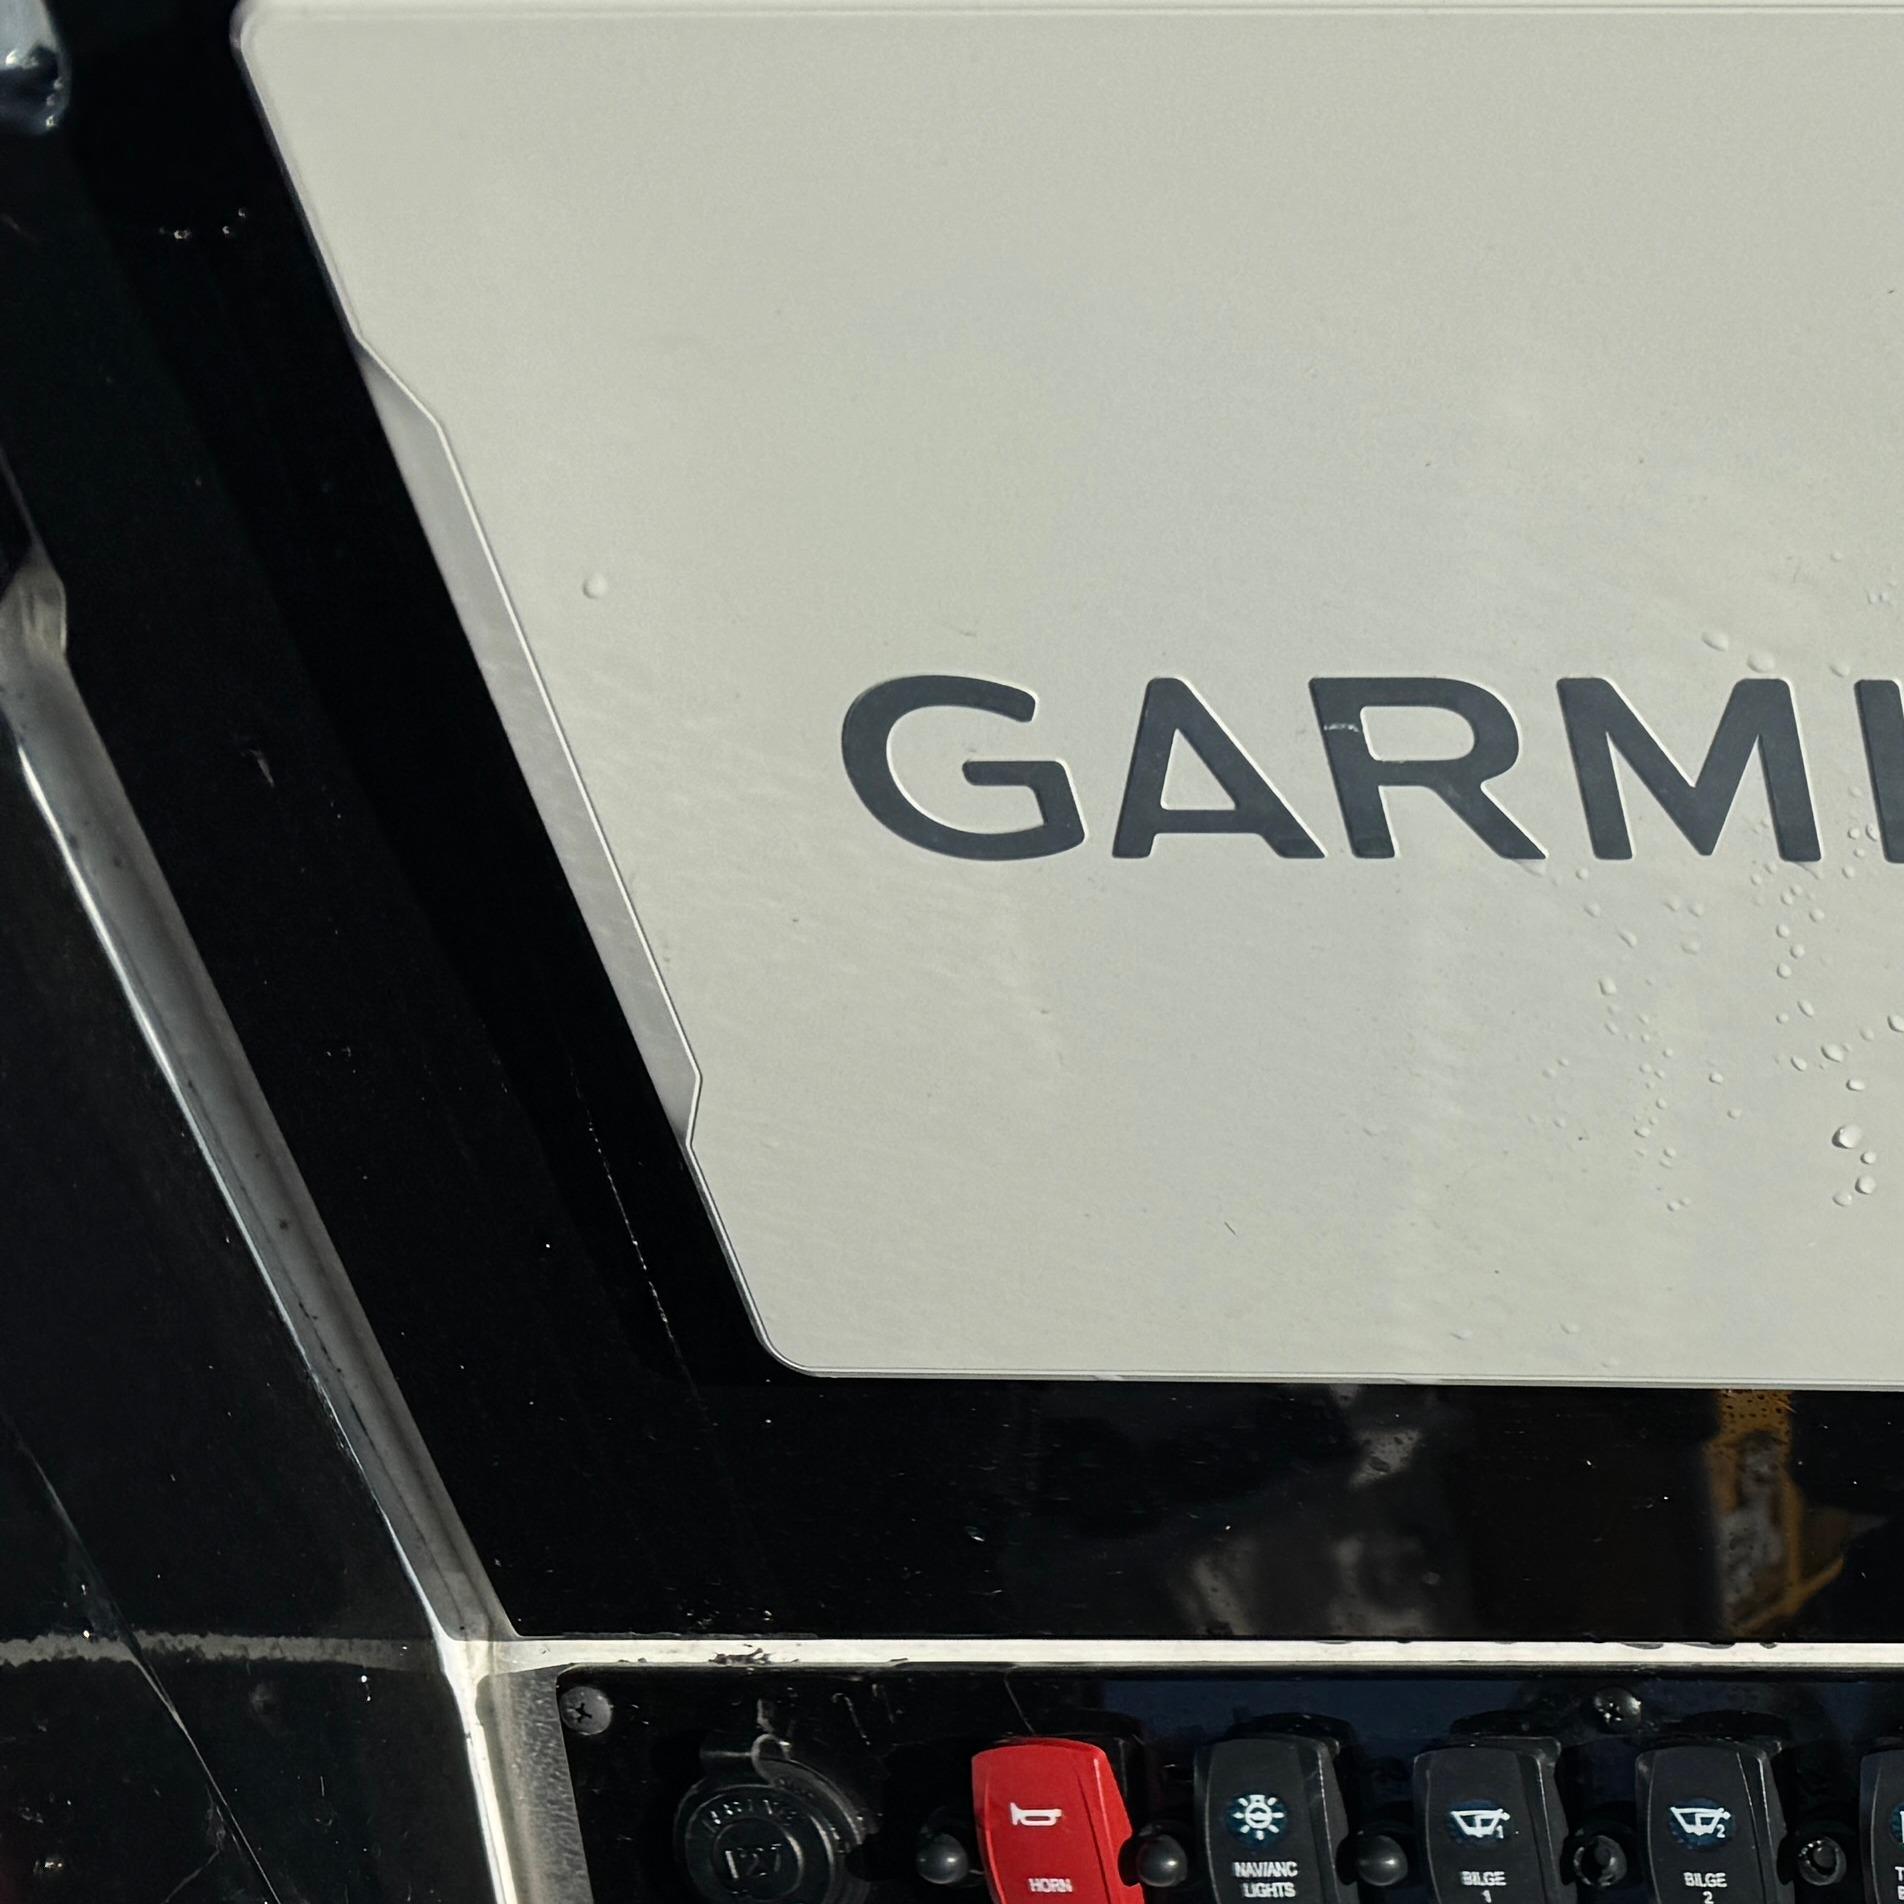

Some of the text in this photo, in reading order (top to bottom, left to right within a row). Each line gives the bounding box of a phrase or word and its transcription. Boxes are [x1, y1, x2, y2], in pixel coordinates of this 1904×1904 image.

[1028, 1878, 1072, 1893] HORN
[1460, 1871, 1506, 1887] BILGE
[1683, 1872, 1727, 1888] BILGE
[1241, 1882, 1296, 1898] LIGHTS
[1482, 1890, 1492, 1904] 1
[1703, 1891, 1714, 1904] 2
